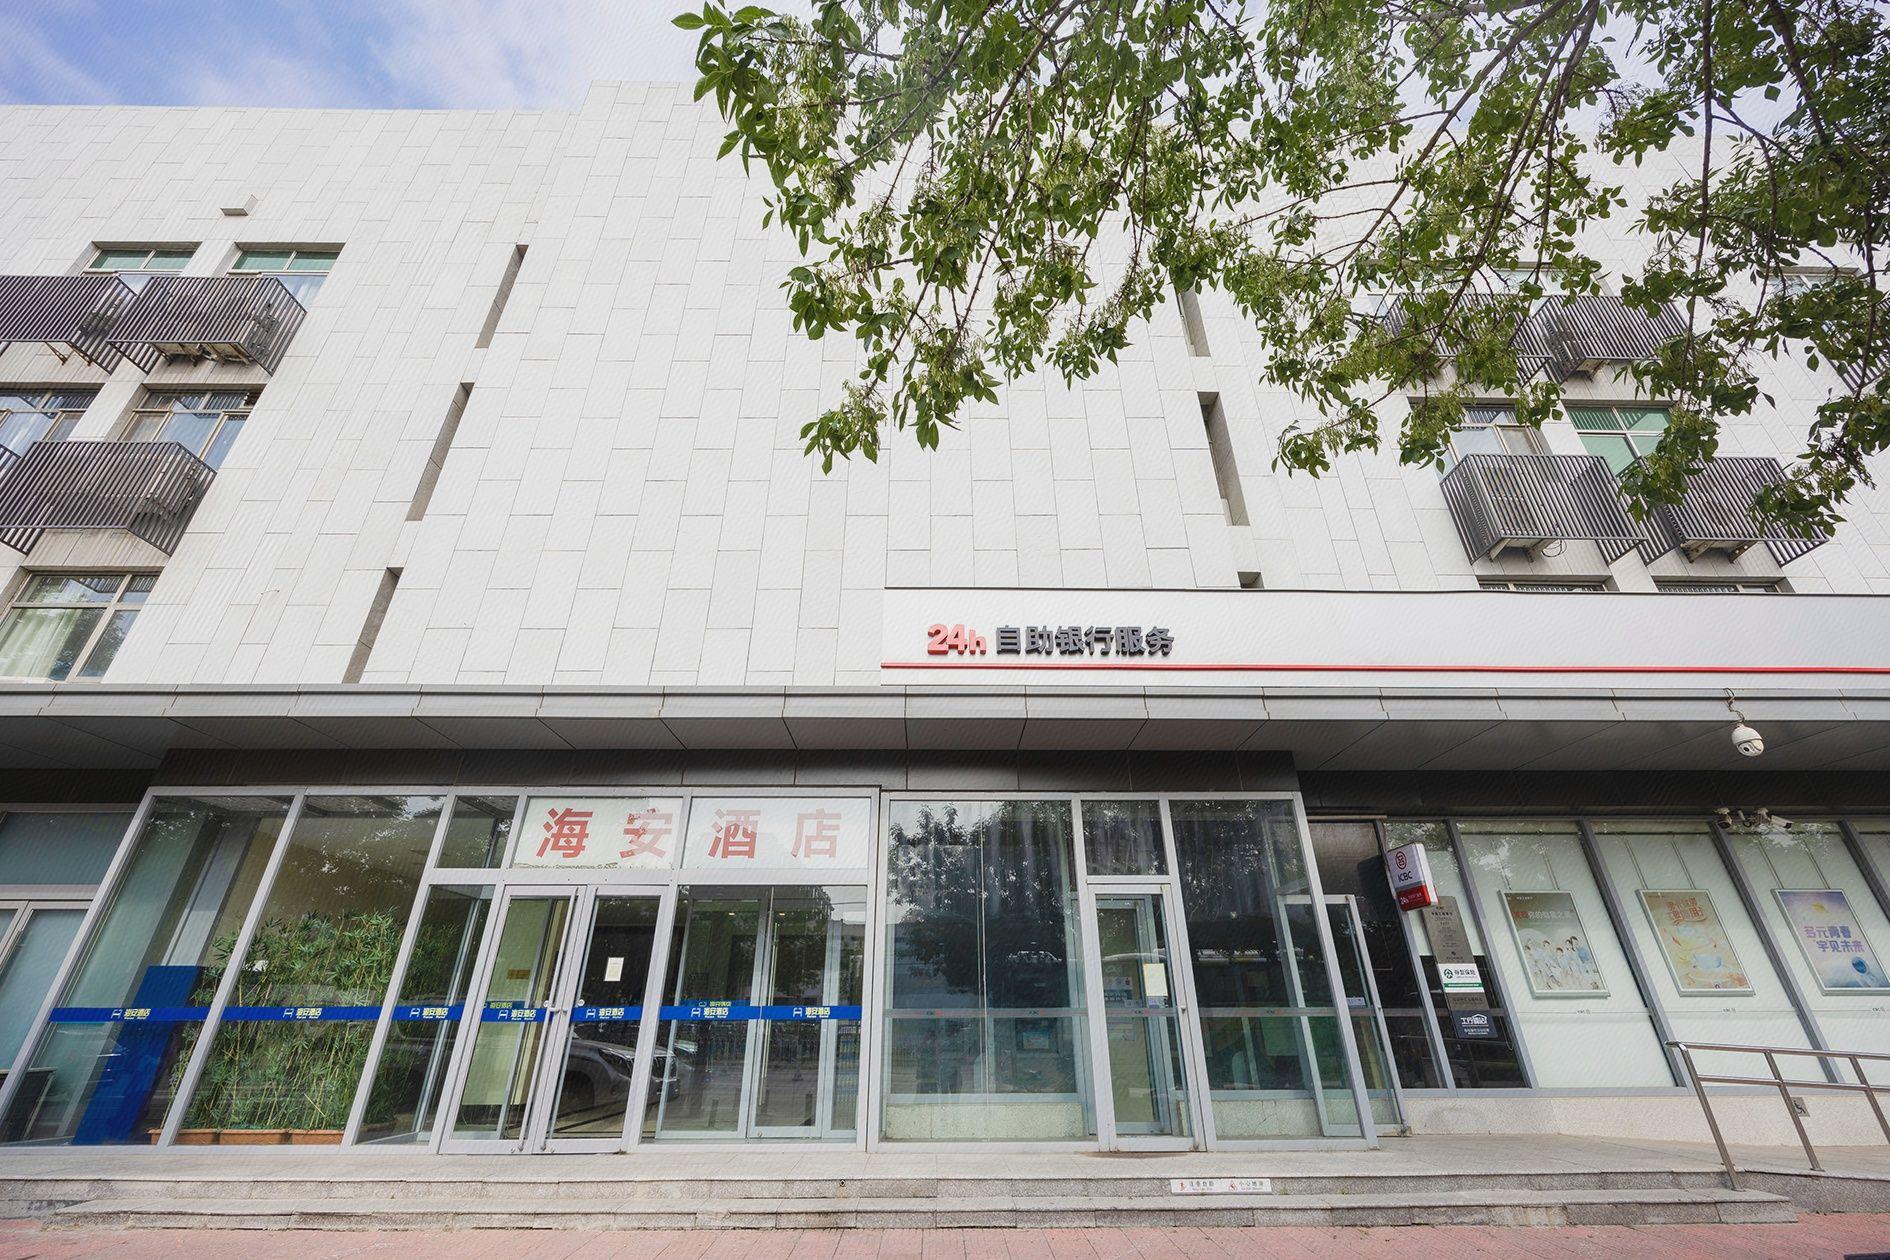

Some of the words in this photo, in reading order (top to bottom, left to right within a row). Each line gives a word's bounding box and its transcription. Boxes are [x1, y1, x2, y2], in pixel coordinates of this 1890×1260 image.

[927, 624, 987, 655] 24h
[996, 625, 1175, 655] 自助银行服务
[536, 808, 842, 859] 海安酒店
